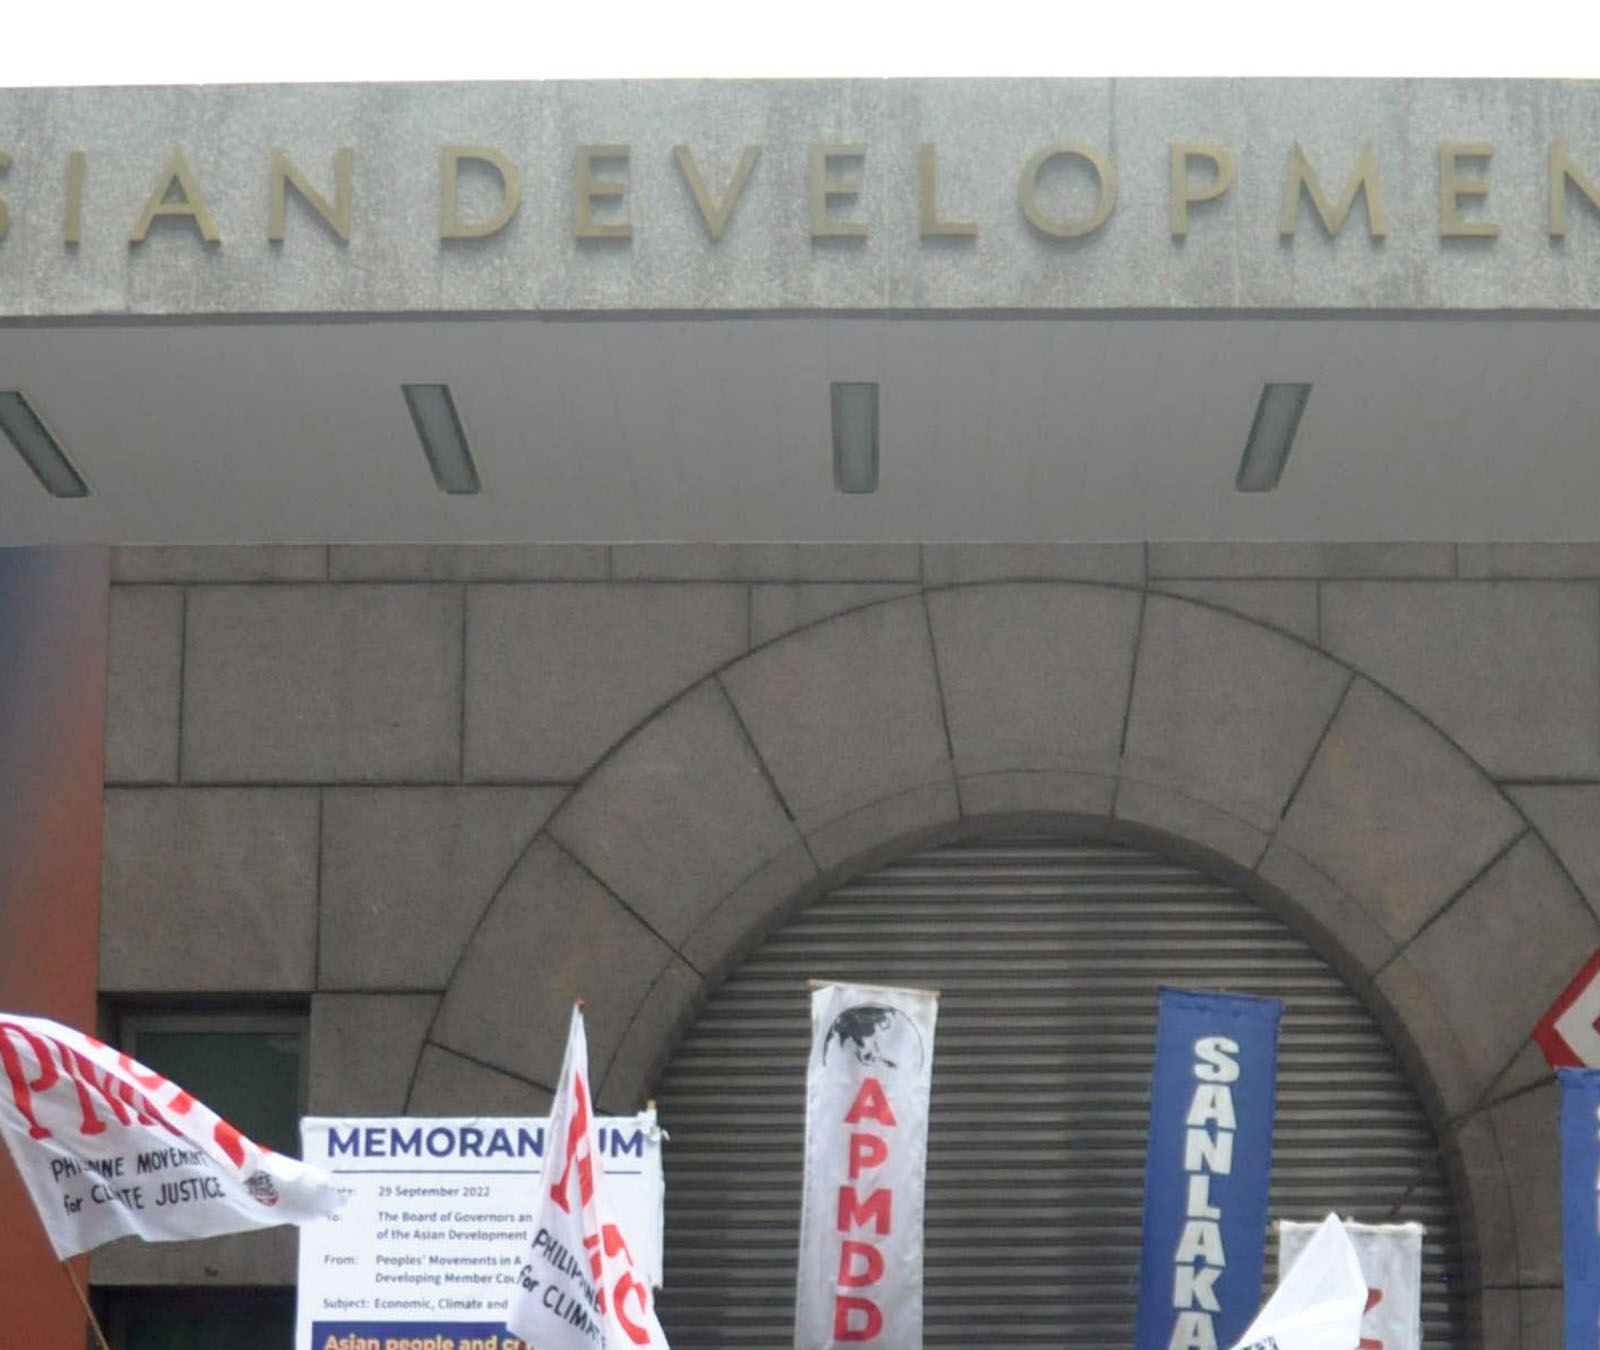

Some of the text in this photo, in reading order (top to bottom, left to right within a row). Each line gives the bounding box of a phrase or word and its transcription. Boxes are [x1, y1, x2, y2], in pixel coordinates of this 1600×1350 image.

[326, 1127, 644, 1158] MEMORANM
[155, 1175, 227, 1207] JUSTICE
[395, 1185, 459, 1202] September
[378, 1211, 399, 1223] The
[402, 1211, 437, 1223] Board
[454, 1211, 515, 1224] Governors
[833, 1076, 897, 1344] APMDD
[391, 1229, 410, 1241] the
[413, 1229, 446, 1241] Asian
[448, 1229, 528, 1245] Development
[324, 1254, 357, 1266] From:
[429, 1254, 497, 1267] Movements
[375, 1272, 442, 1288] Developing
[445, 1272, 492, 1285] Member
[323, 1297, 370, 1312] Subject:
[374, 1298, 434, 1312] Economic,
[438, 1297, 483, 1310] Climate
